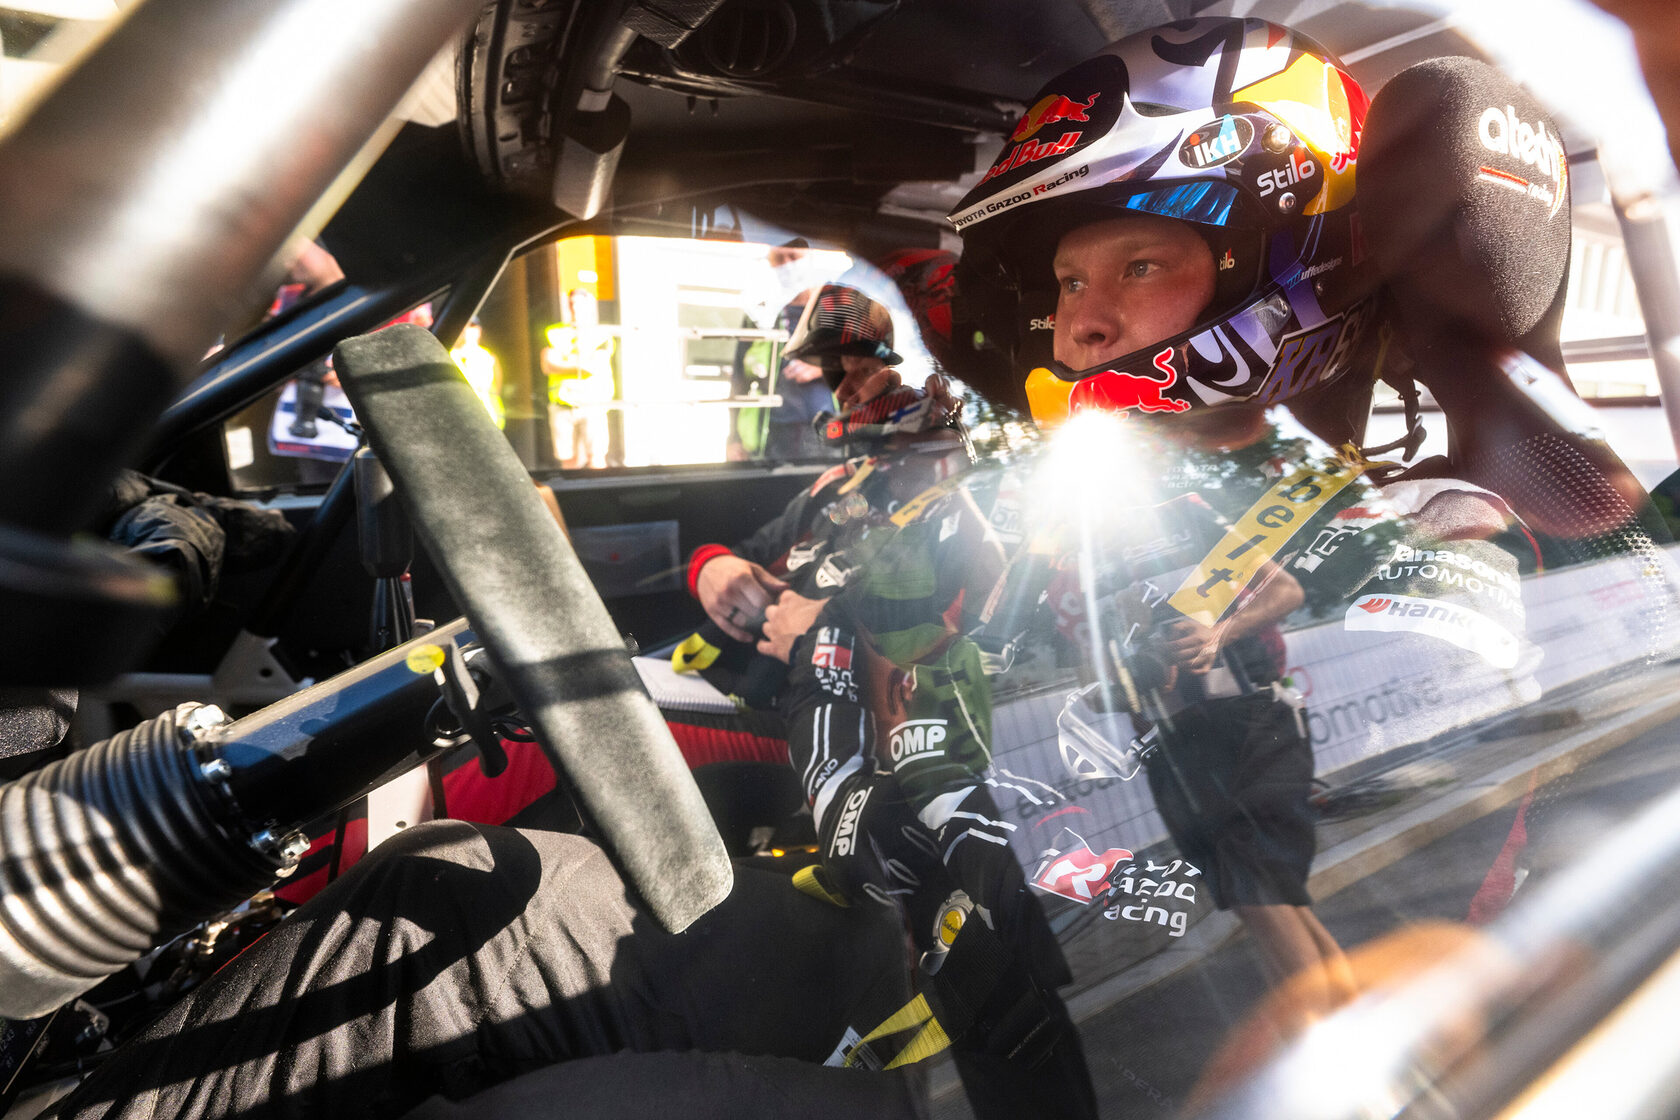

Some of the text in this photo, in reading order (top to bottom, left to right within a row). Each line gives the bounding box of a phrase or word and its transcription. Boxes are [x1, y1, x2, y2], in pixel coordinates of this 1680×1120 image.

[1010, 131, 1083, 170] Bull
[986, 191, 1032, 214] GAZOO
[1032, 164, 1090, 196] Racing
[890, 725, 947, 762] OMP
[835, 789, 867, 857] OMP
